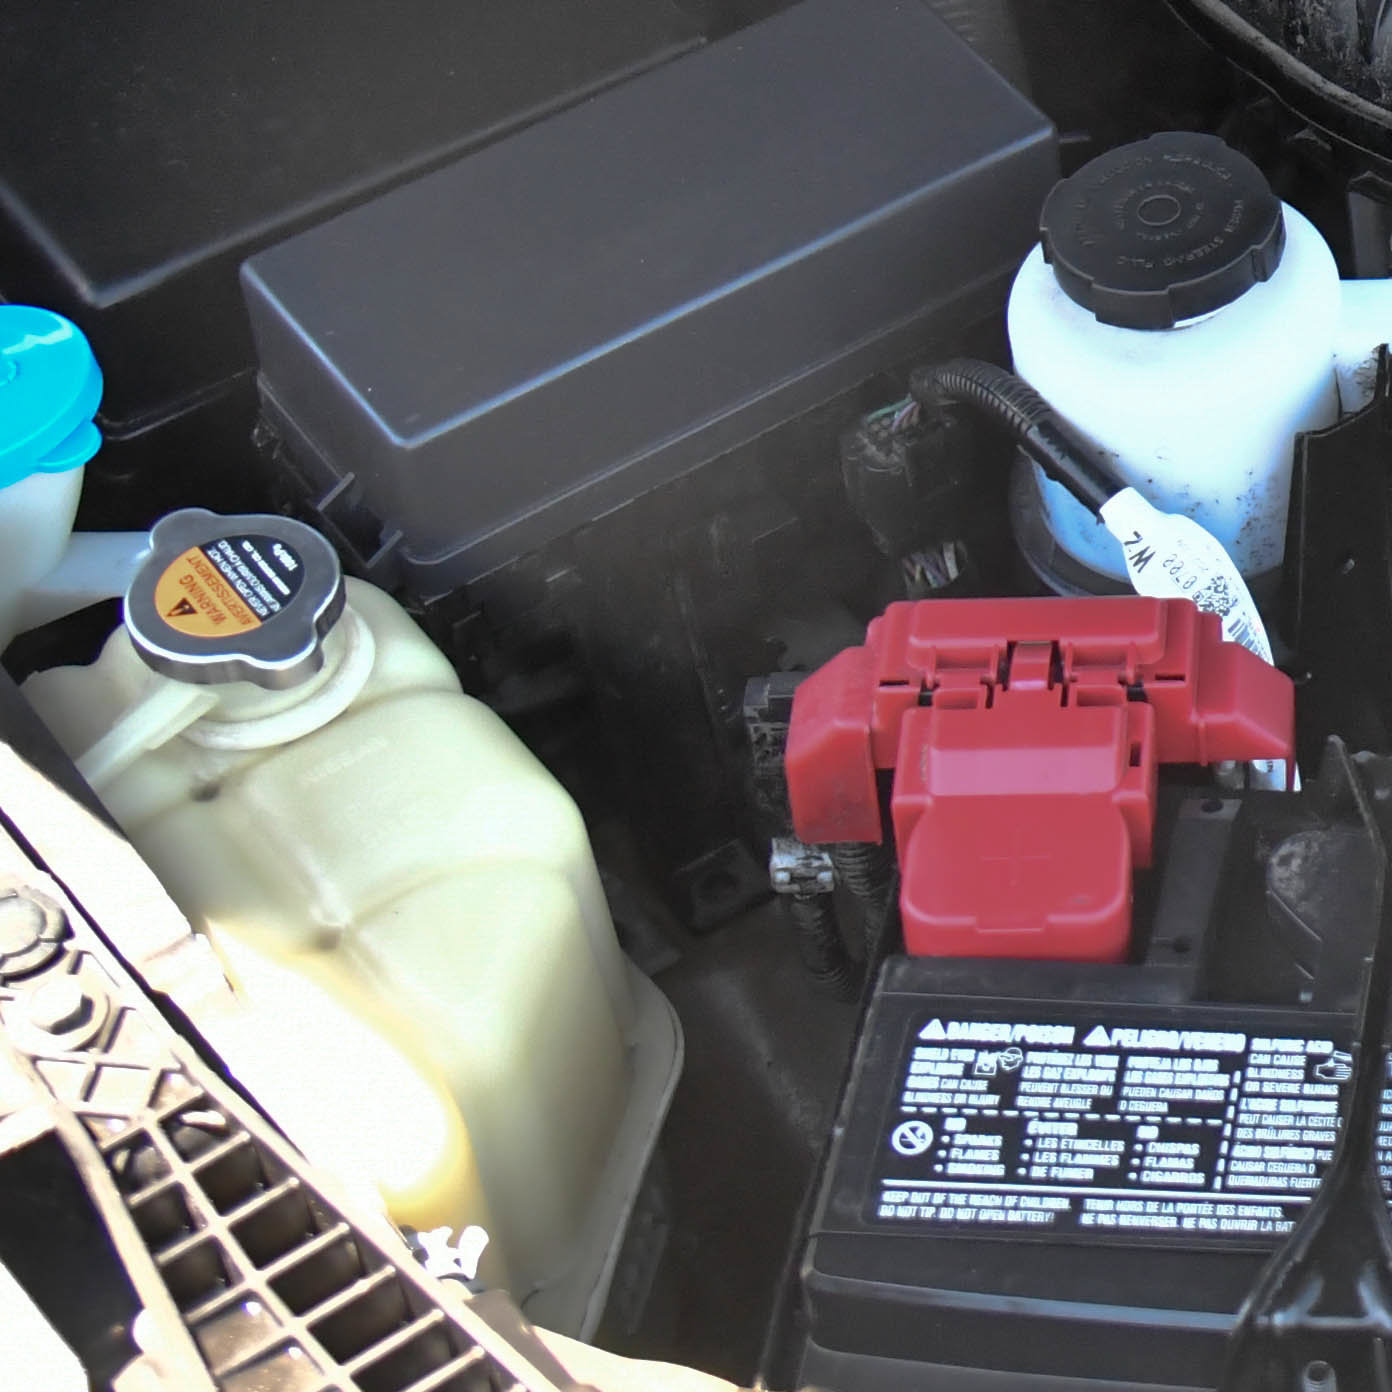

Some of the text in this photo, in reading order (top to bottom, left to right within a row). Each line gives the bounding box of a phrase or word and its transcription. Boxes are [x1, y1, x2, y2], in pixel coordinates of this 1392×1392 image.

[186, 555, 253, 625] AVERTISSEMENT
[179, 574, 227, 625] WARNING
[1250, 1053, 1307, 1067] CAN CAUSE
[1296, 1115, 1307, 1126] LA
[1037, 1139, 1056, 1149] LES
[950, 1148, 1000, 1161] FLAMES
[1033, 1152, 1056, 1164] LES
[1143, 1156, 1194, 1169] FLAMAS
[1030, 1166, 1094, 1181] DE FUMER
[882, 1191, 909, 1203] KEEP
[911, 1192, 931, 1203] OUT
[933, 1192, 946, 1204] OF
[948, 1193, 967, 1205] THE
[1004, 1196, 1018, 1207] OF
[1147, 1201, 1160, 1212] DE
[1162, 1202, 1174, 1213] LA
[1216, 1203, 1235, 1215] DES
[1260, 1220, 1273, 1232] LA
